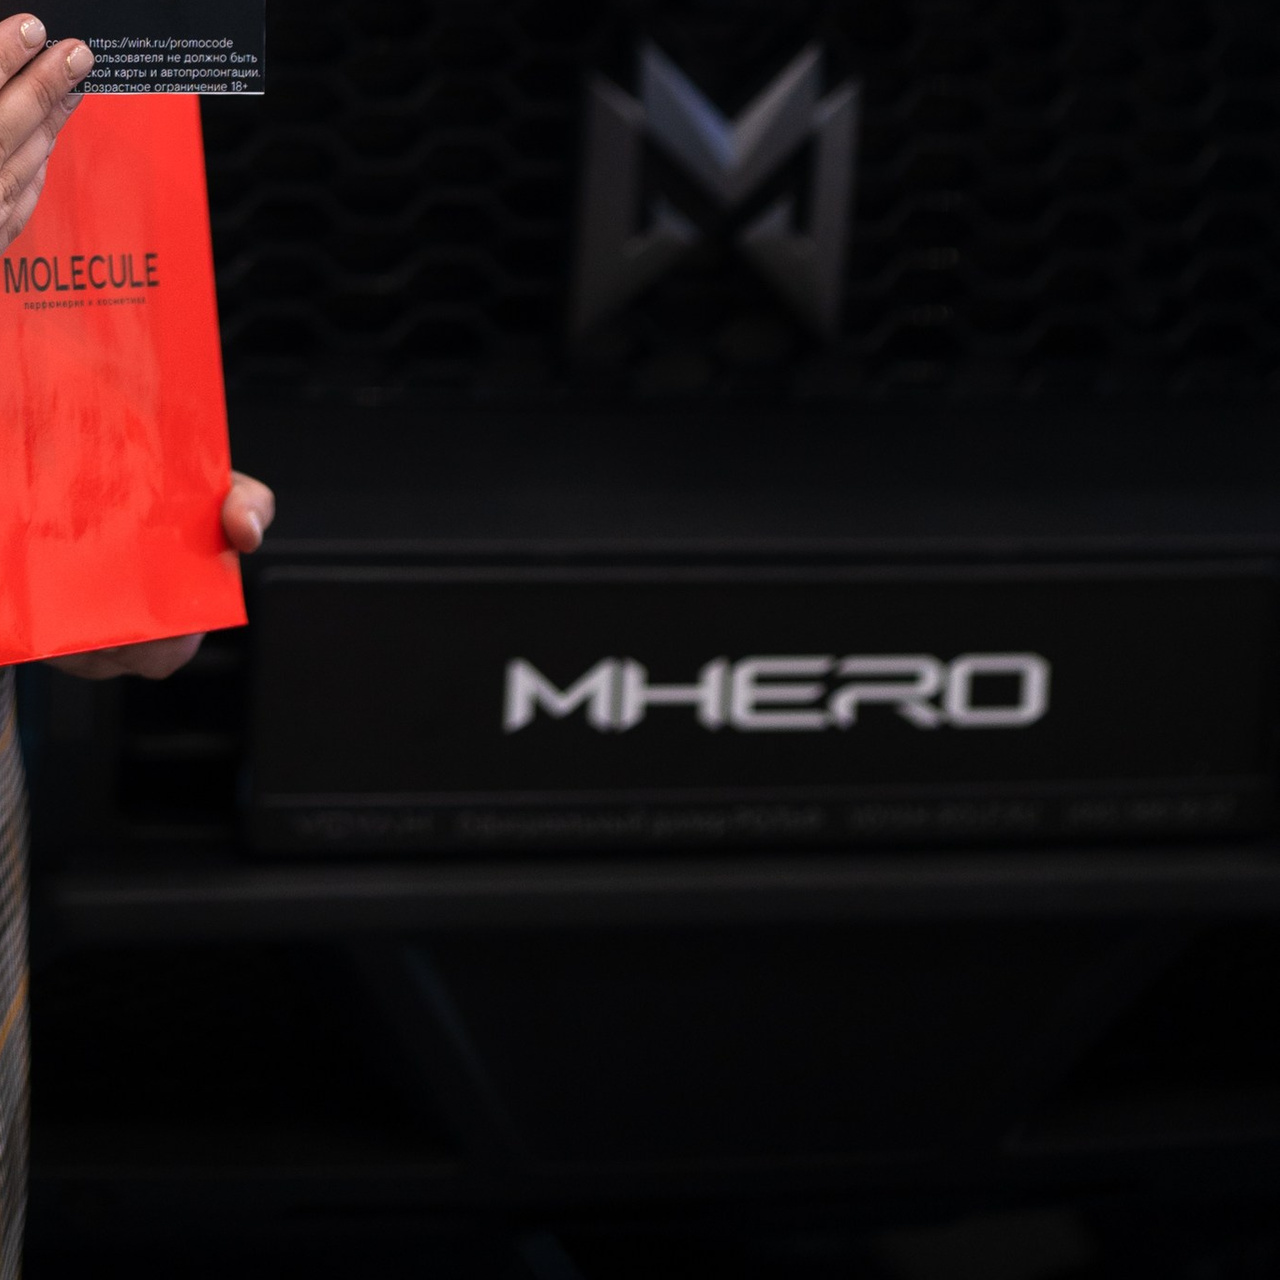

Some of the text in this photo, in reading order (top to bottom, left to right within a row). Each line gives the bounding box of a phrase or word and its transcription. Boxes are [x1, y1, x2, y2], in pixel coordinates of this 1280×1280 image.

[89, 36, 234, 52] https://wink.ru/promocode
[94, 51, 258, 64] ользователя не должно быть
[114, 68, 147, 80] карты
[150, 68, 158, 78] и
[160, 67, 261, 80] автопролонгации.
[83, 80, 249, 93] Возрастное ограничение 18+
[3, 252, 160, 294] MOLECULE
[502, 651, 1050, 733] MHERO
